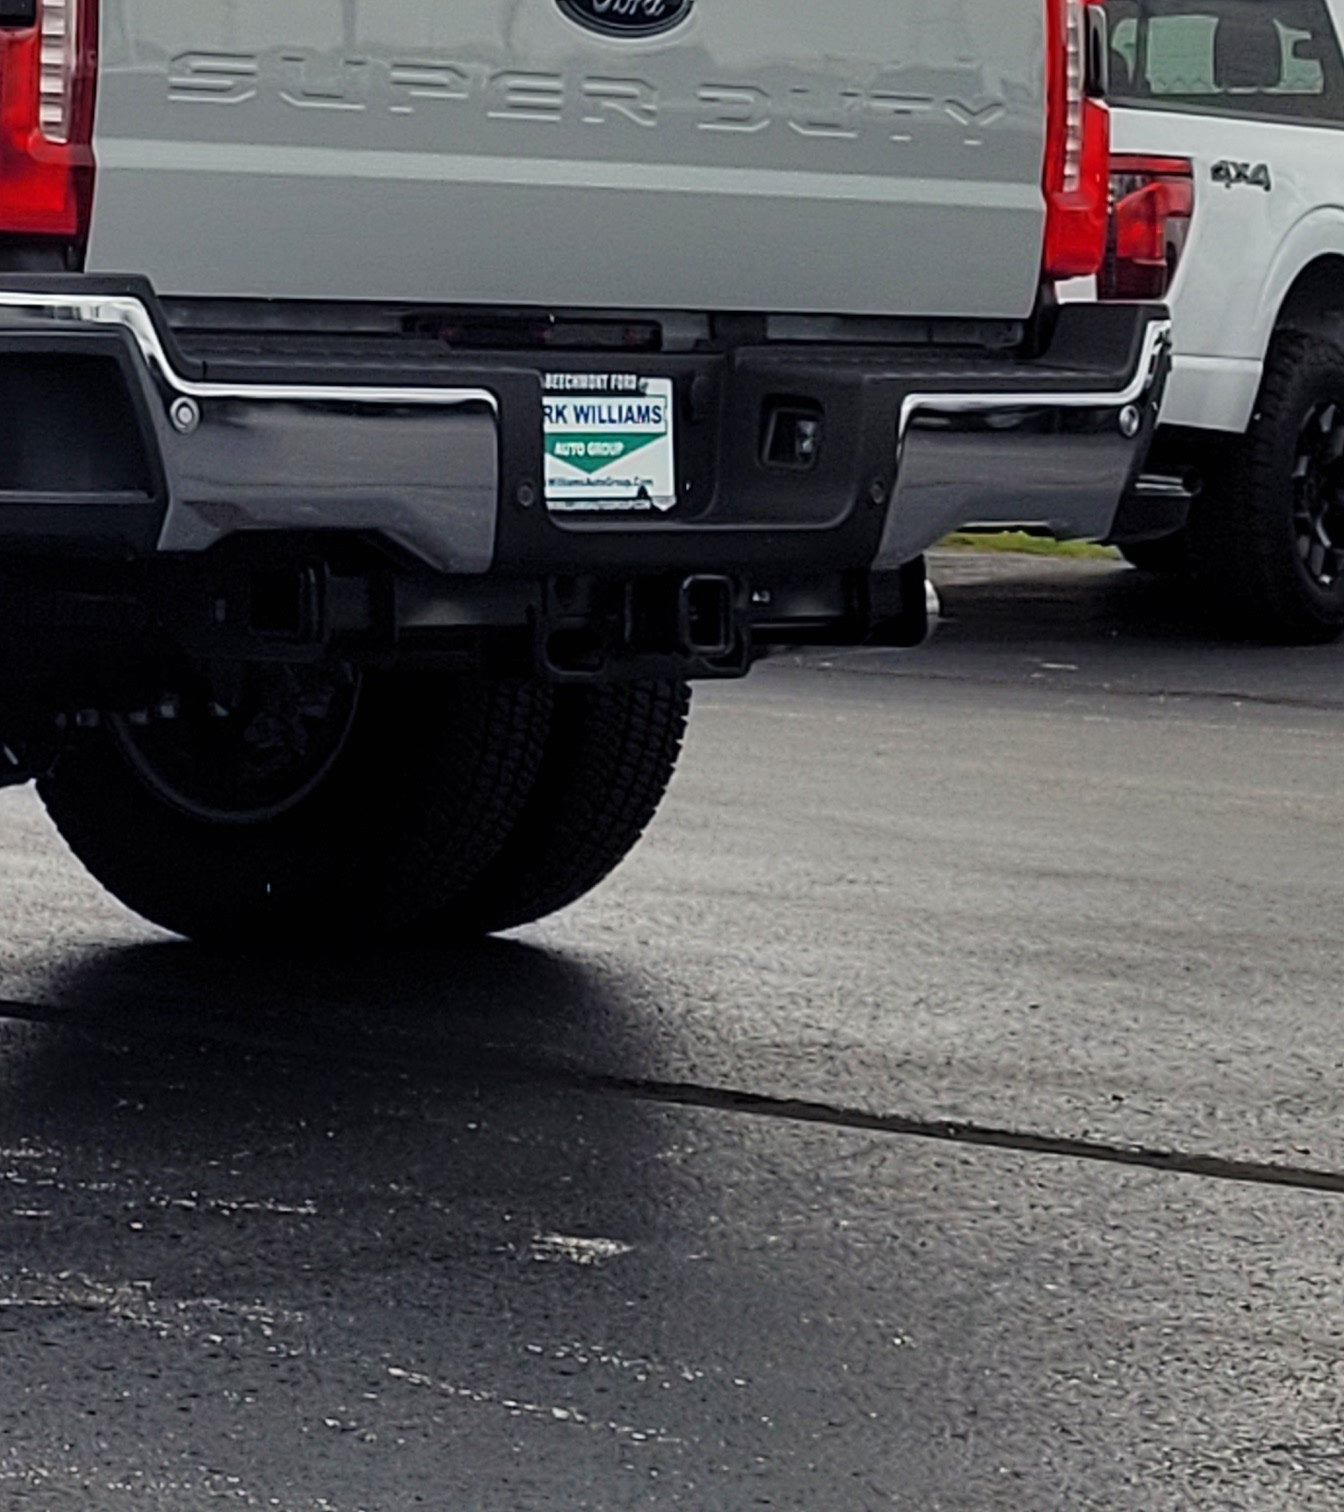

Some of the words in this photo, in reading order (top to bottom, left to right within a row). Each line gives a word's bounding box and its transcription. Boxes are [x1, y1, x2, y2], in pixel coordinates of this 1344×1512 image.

[167, 50, 658, 128] SUPER
[698, 83, 1005, 147] DUTY
[573, 404, 662, 425] WILLIAMS
[554, 442, 585, 456] AUTO
[587, 442, 624, 456] GROUP
